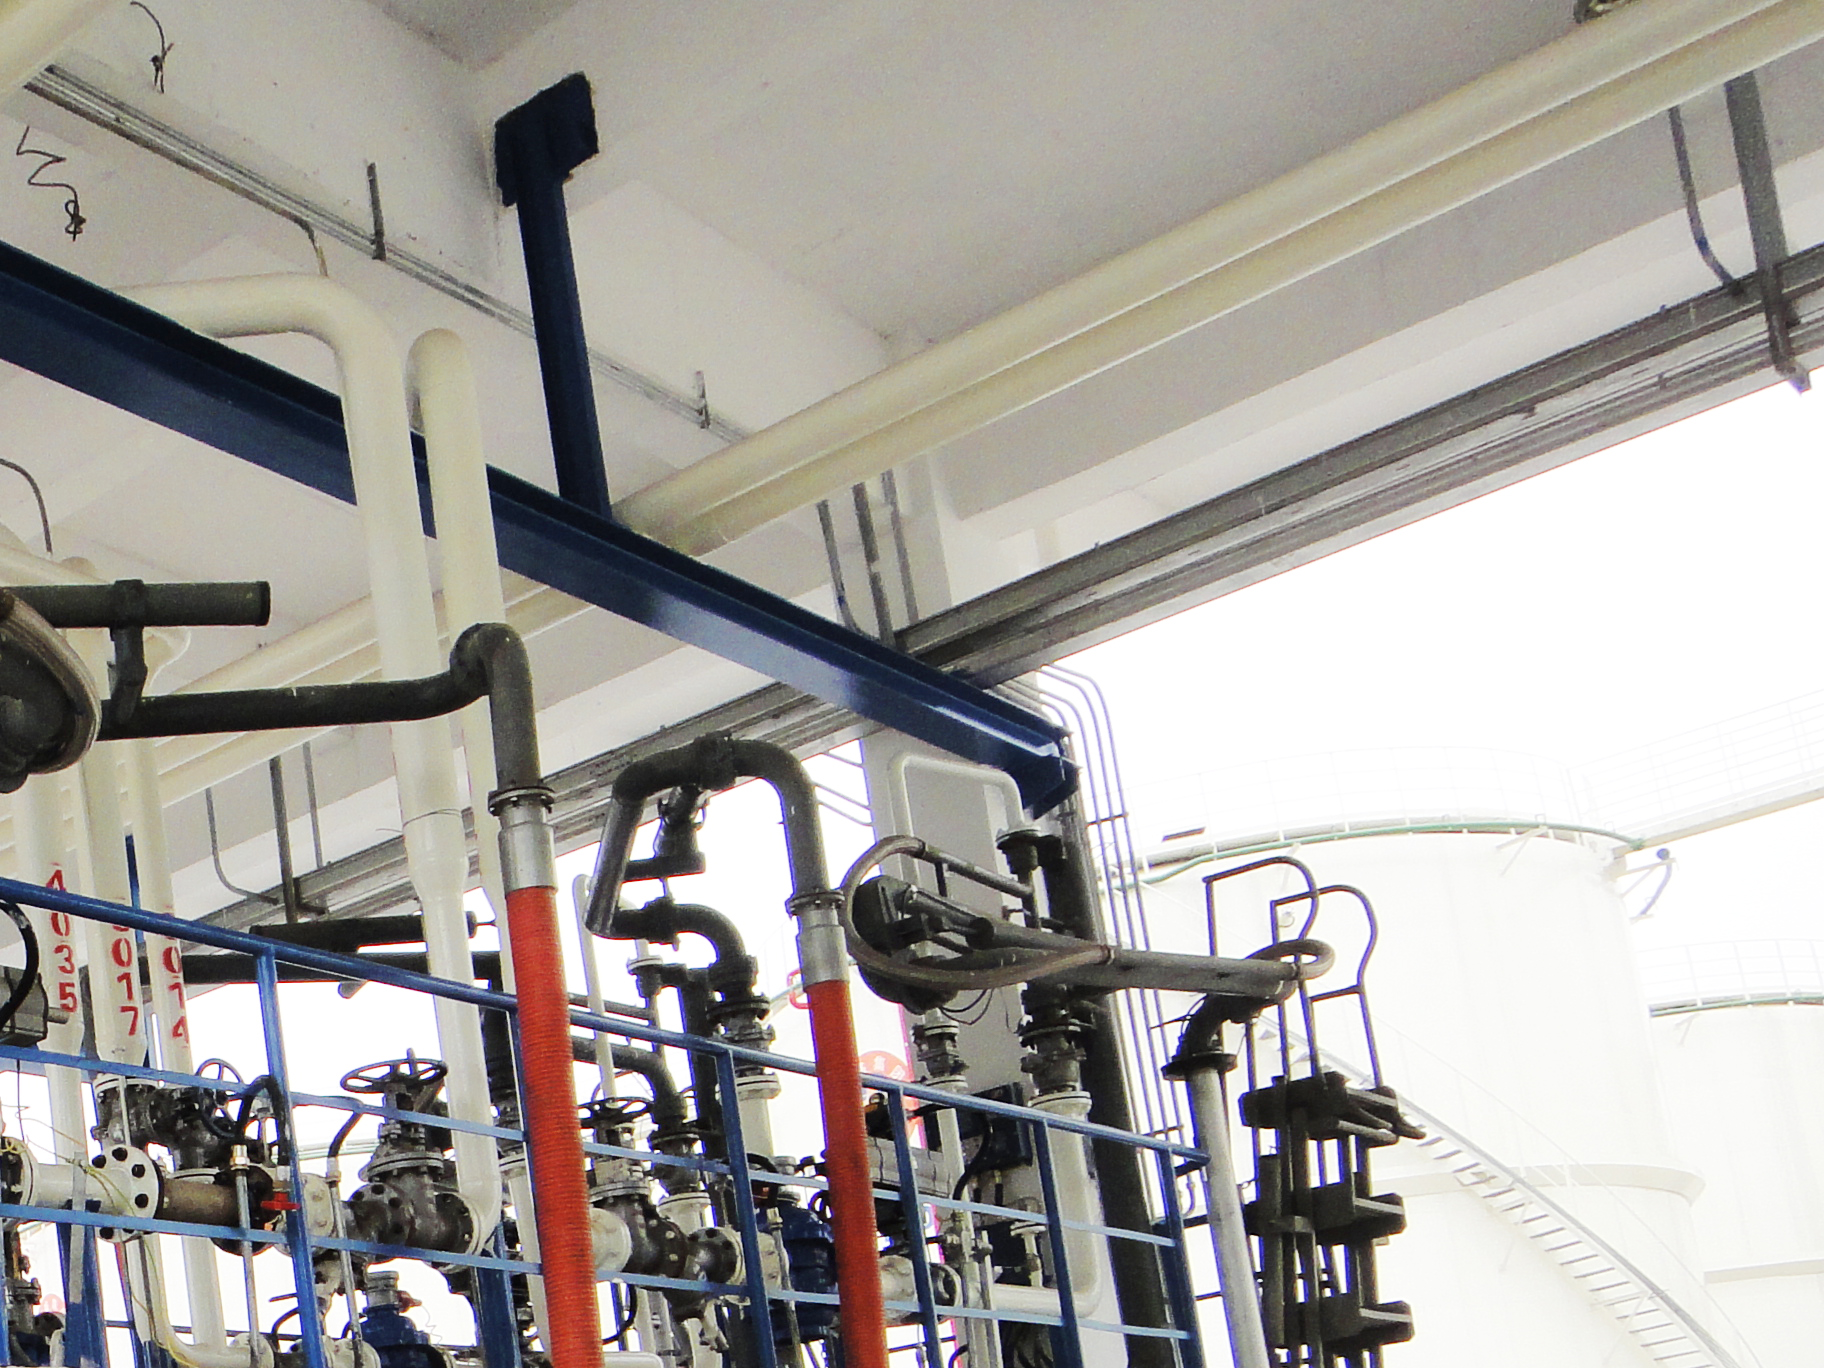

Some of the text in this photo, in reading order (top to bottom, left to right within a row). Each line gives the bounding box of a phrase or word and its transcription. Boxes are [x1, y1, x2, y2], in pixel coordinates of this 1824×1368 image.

[45, 868, 78, 1013] 4035
[110, 922, 140, 1037] 017
[162, 911, 190, 1045] 014
